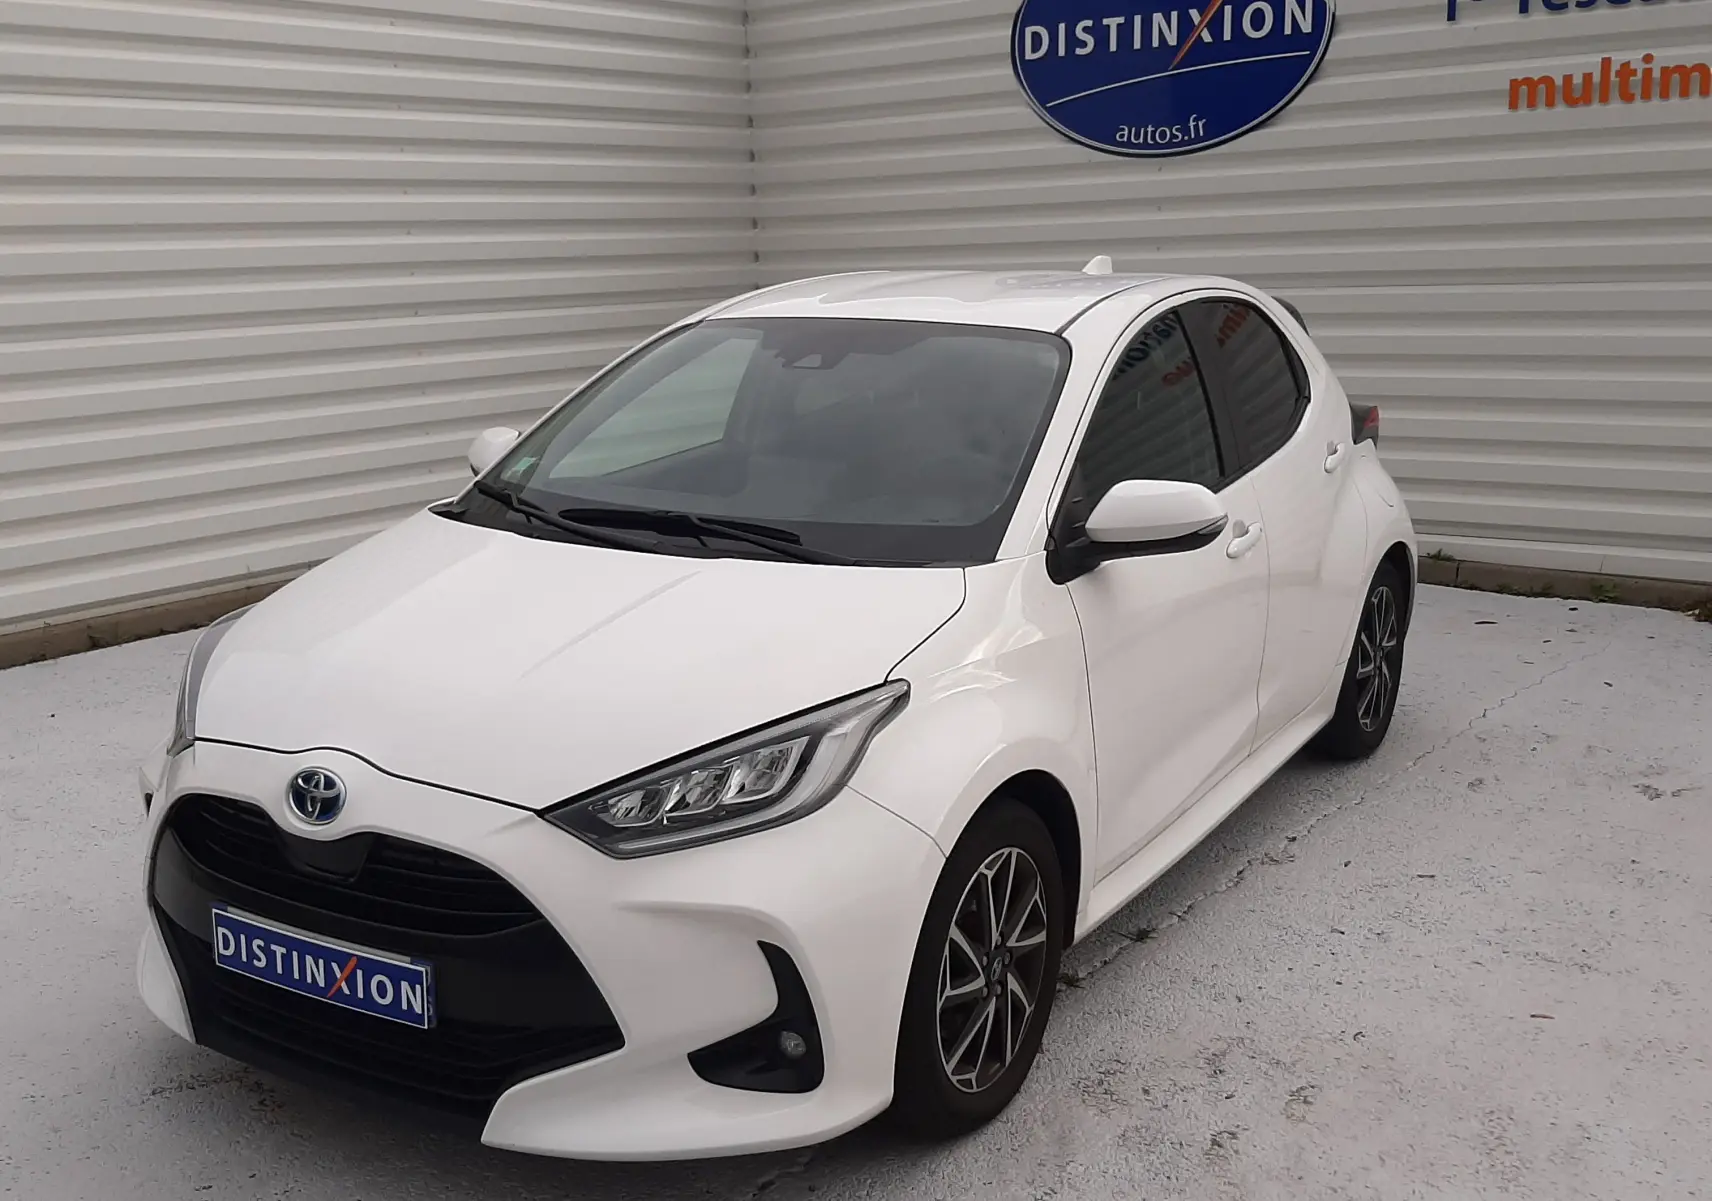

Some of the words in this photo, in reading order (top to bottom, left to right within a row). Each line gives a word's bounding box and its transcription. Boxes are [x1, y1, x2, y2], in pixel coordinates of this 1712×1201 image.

[1024, 0, 1312, 60] DISTINXION
[1115, 114, 1206, 144] autos.fr
[216, 926, 422, 1014] DISTINXION
